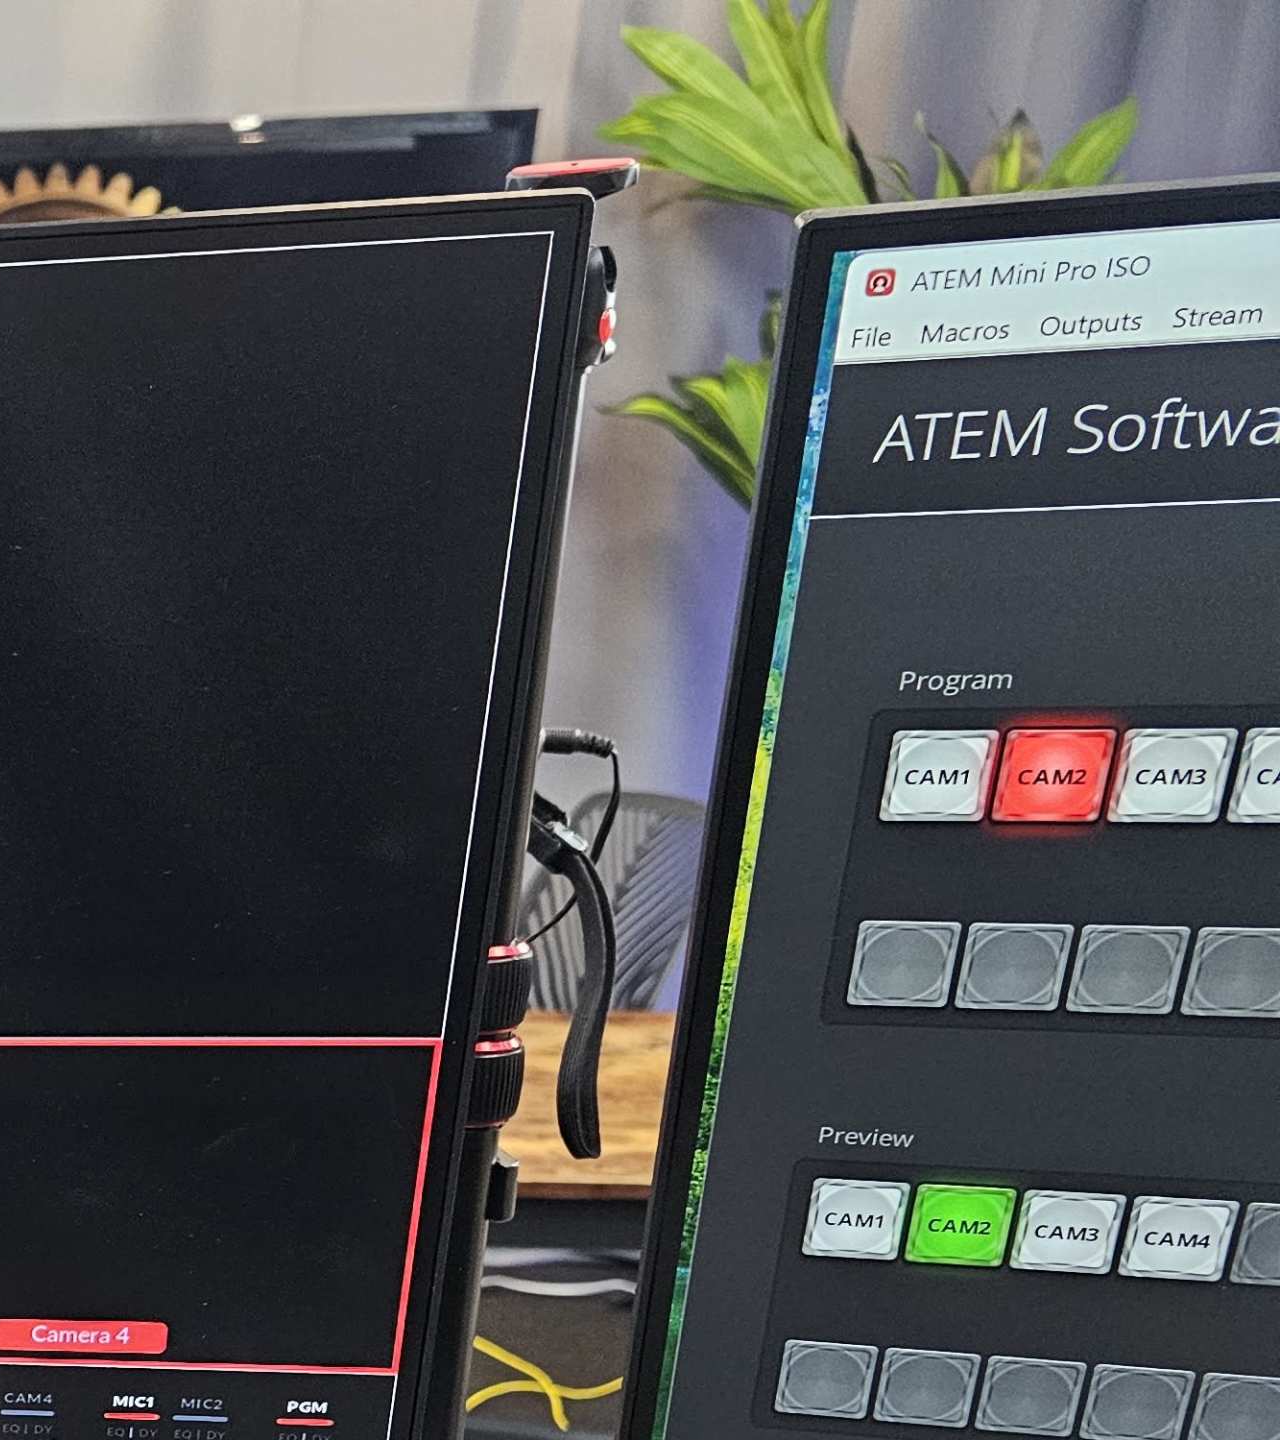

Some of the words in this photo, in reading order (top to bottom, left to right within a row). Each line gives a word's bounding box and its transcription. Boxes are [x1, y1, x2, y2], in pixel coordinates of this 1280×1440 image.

[911, 268, 980, 292] ATEM
[992, 263, 1046, 287] Mini
[1055, 261, 1096, 281] Pro
[1106, 255, 1150, 278] ISO
[851, 327, 892, 349] File
[920, 321, 1010, 345] Macros
[1040, 313, 1142, 338] Outputs
[1172, 306, 1263, 328] Stream
[872, 407, 1047, 463] ATEM
[899, 671, 1013, 695] Program
[905, 768, 971, 786] CAM1
[1017, 768, 1087, 786] CAM2
[1135, 768, 1207, 786] CAM3
[818, 1126, 914, 1148] Preview
[824, 1211, 885, 1228] CAM1
[928, 1218, 992, 1235] CAM2
[1034, 1224, 1099, 1242] CAM3
[1144, 1230, 1210, 1249] CAM4
[31, 1325, 111, 1343] Camera
[115, 1327, 130, 1344] 4
[4, 1393, 52, 1404] CAM4
[112, 1396, 155, 1409] MIC1
[180, 1398, 223, 1410] MIC2
[287, 1401, 328, 1414] PGM
